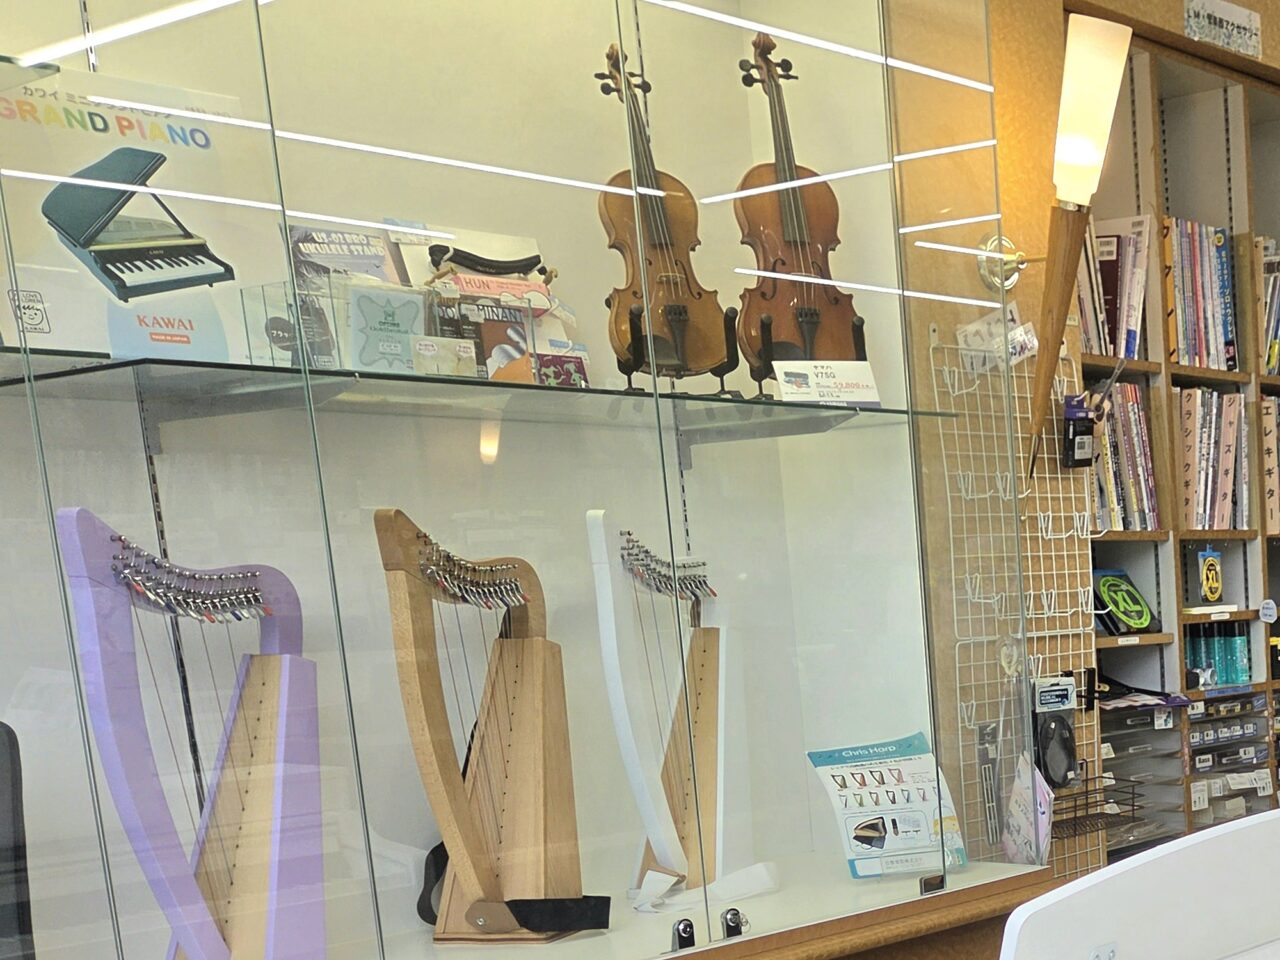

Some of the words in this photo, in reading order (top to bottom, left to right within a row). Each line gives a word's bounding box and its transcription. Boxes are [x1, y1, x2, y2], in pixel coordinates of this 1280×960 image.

[0, 96, 110, 134] GRAND
[115, 115, 211, 149] PIANO
[137, 314, 194, 331] KAWAI
[1183, 392, 1194, 520] クラシックギター
[1263, 406, 1276, 521] エレキギター
[1206, 570, 1220, 587] XL
[1109, 591, 1142, 612] XL
[842, 746, 869, 758] Chris
[870, 744, 896, 755] Harp
